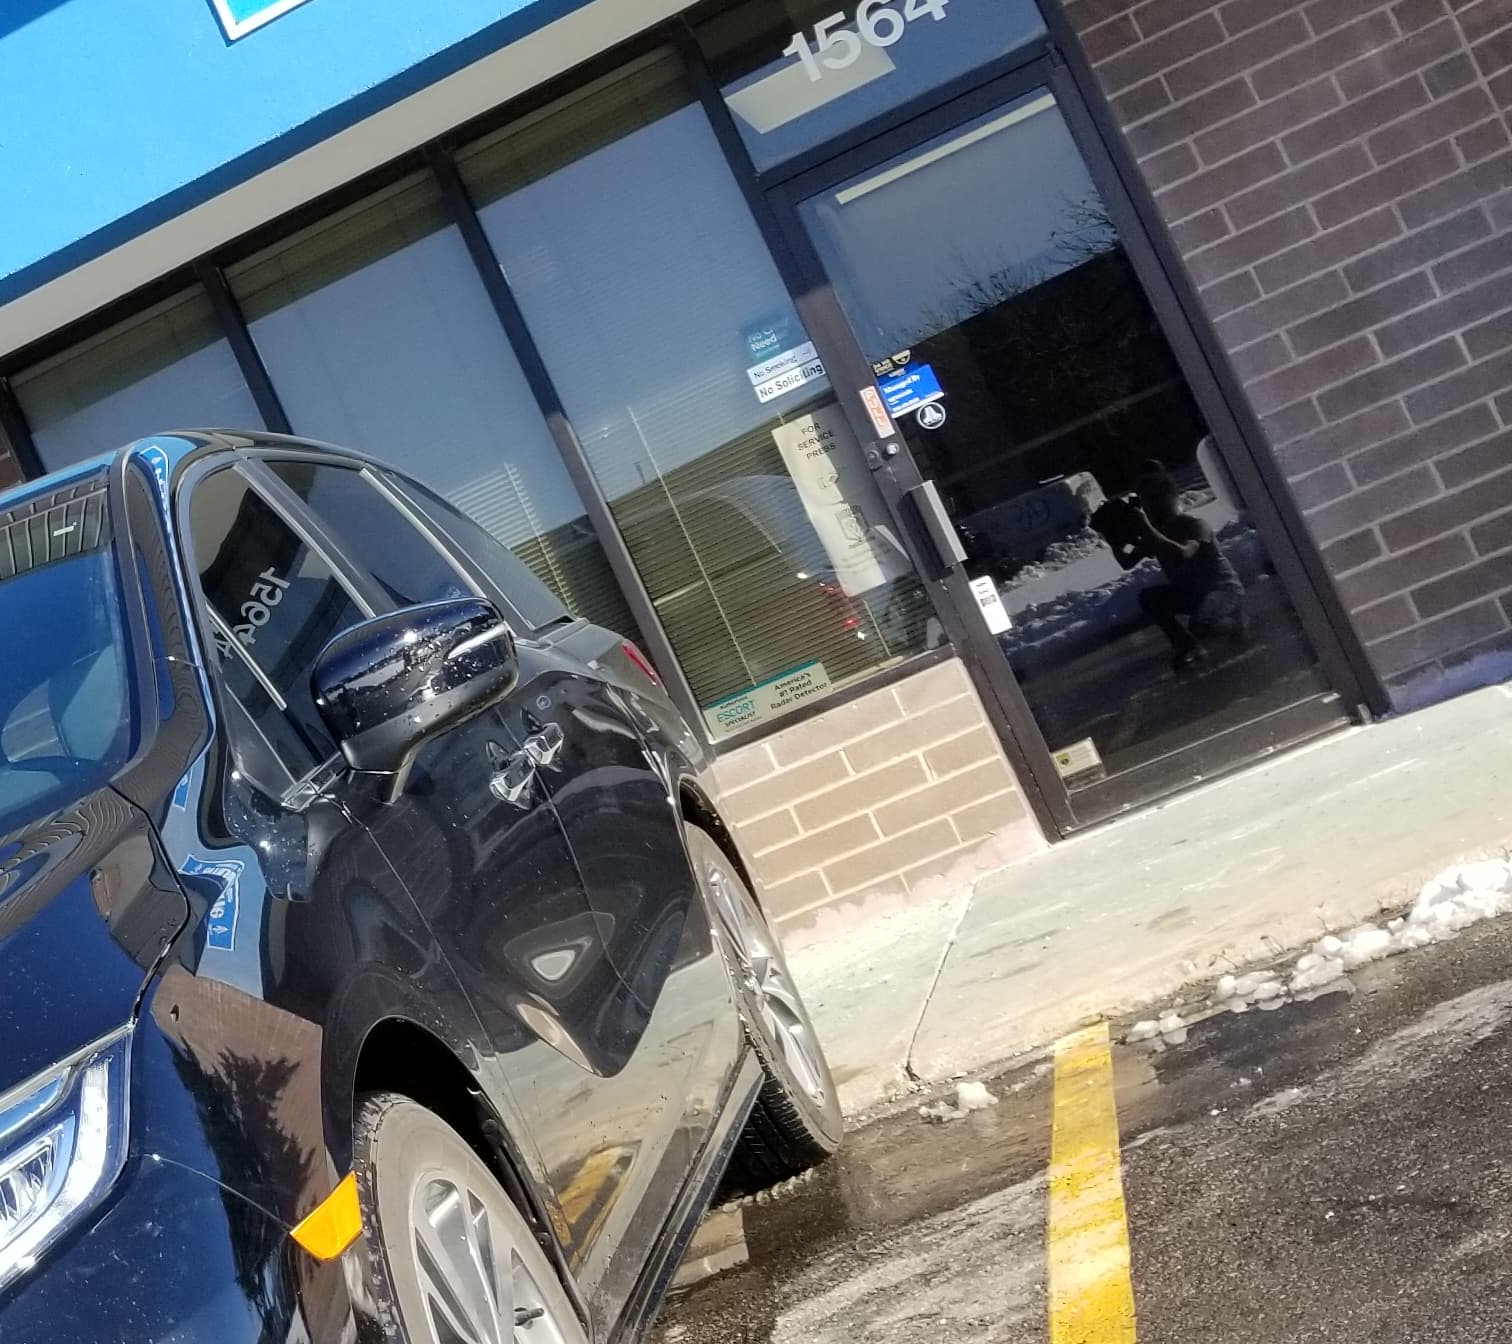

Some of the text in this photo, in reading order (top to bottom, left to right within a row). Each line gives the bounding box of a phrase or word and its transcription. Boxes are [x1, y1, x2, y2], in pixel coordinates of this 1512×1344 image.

[765, 355, 798, 374] Smoking
[758, 364, 824, 398] No Soliciting
[801, 423, 821, 435] FOR
[797, 429, 835, 451] SERVICE
[806, 442, 837, 460] PRESS
[774, 672, 812, 691] America's
[790, 679, 813, 693] Rated
[770, 682, 828, 709] Radar Detector
[716, 700, 755, 723] ESCORT
